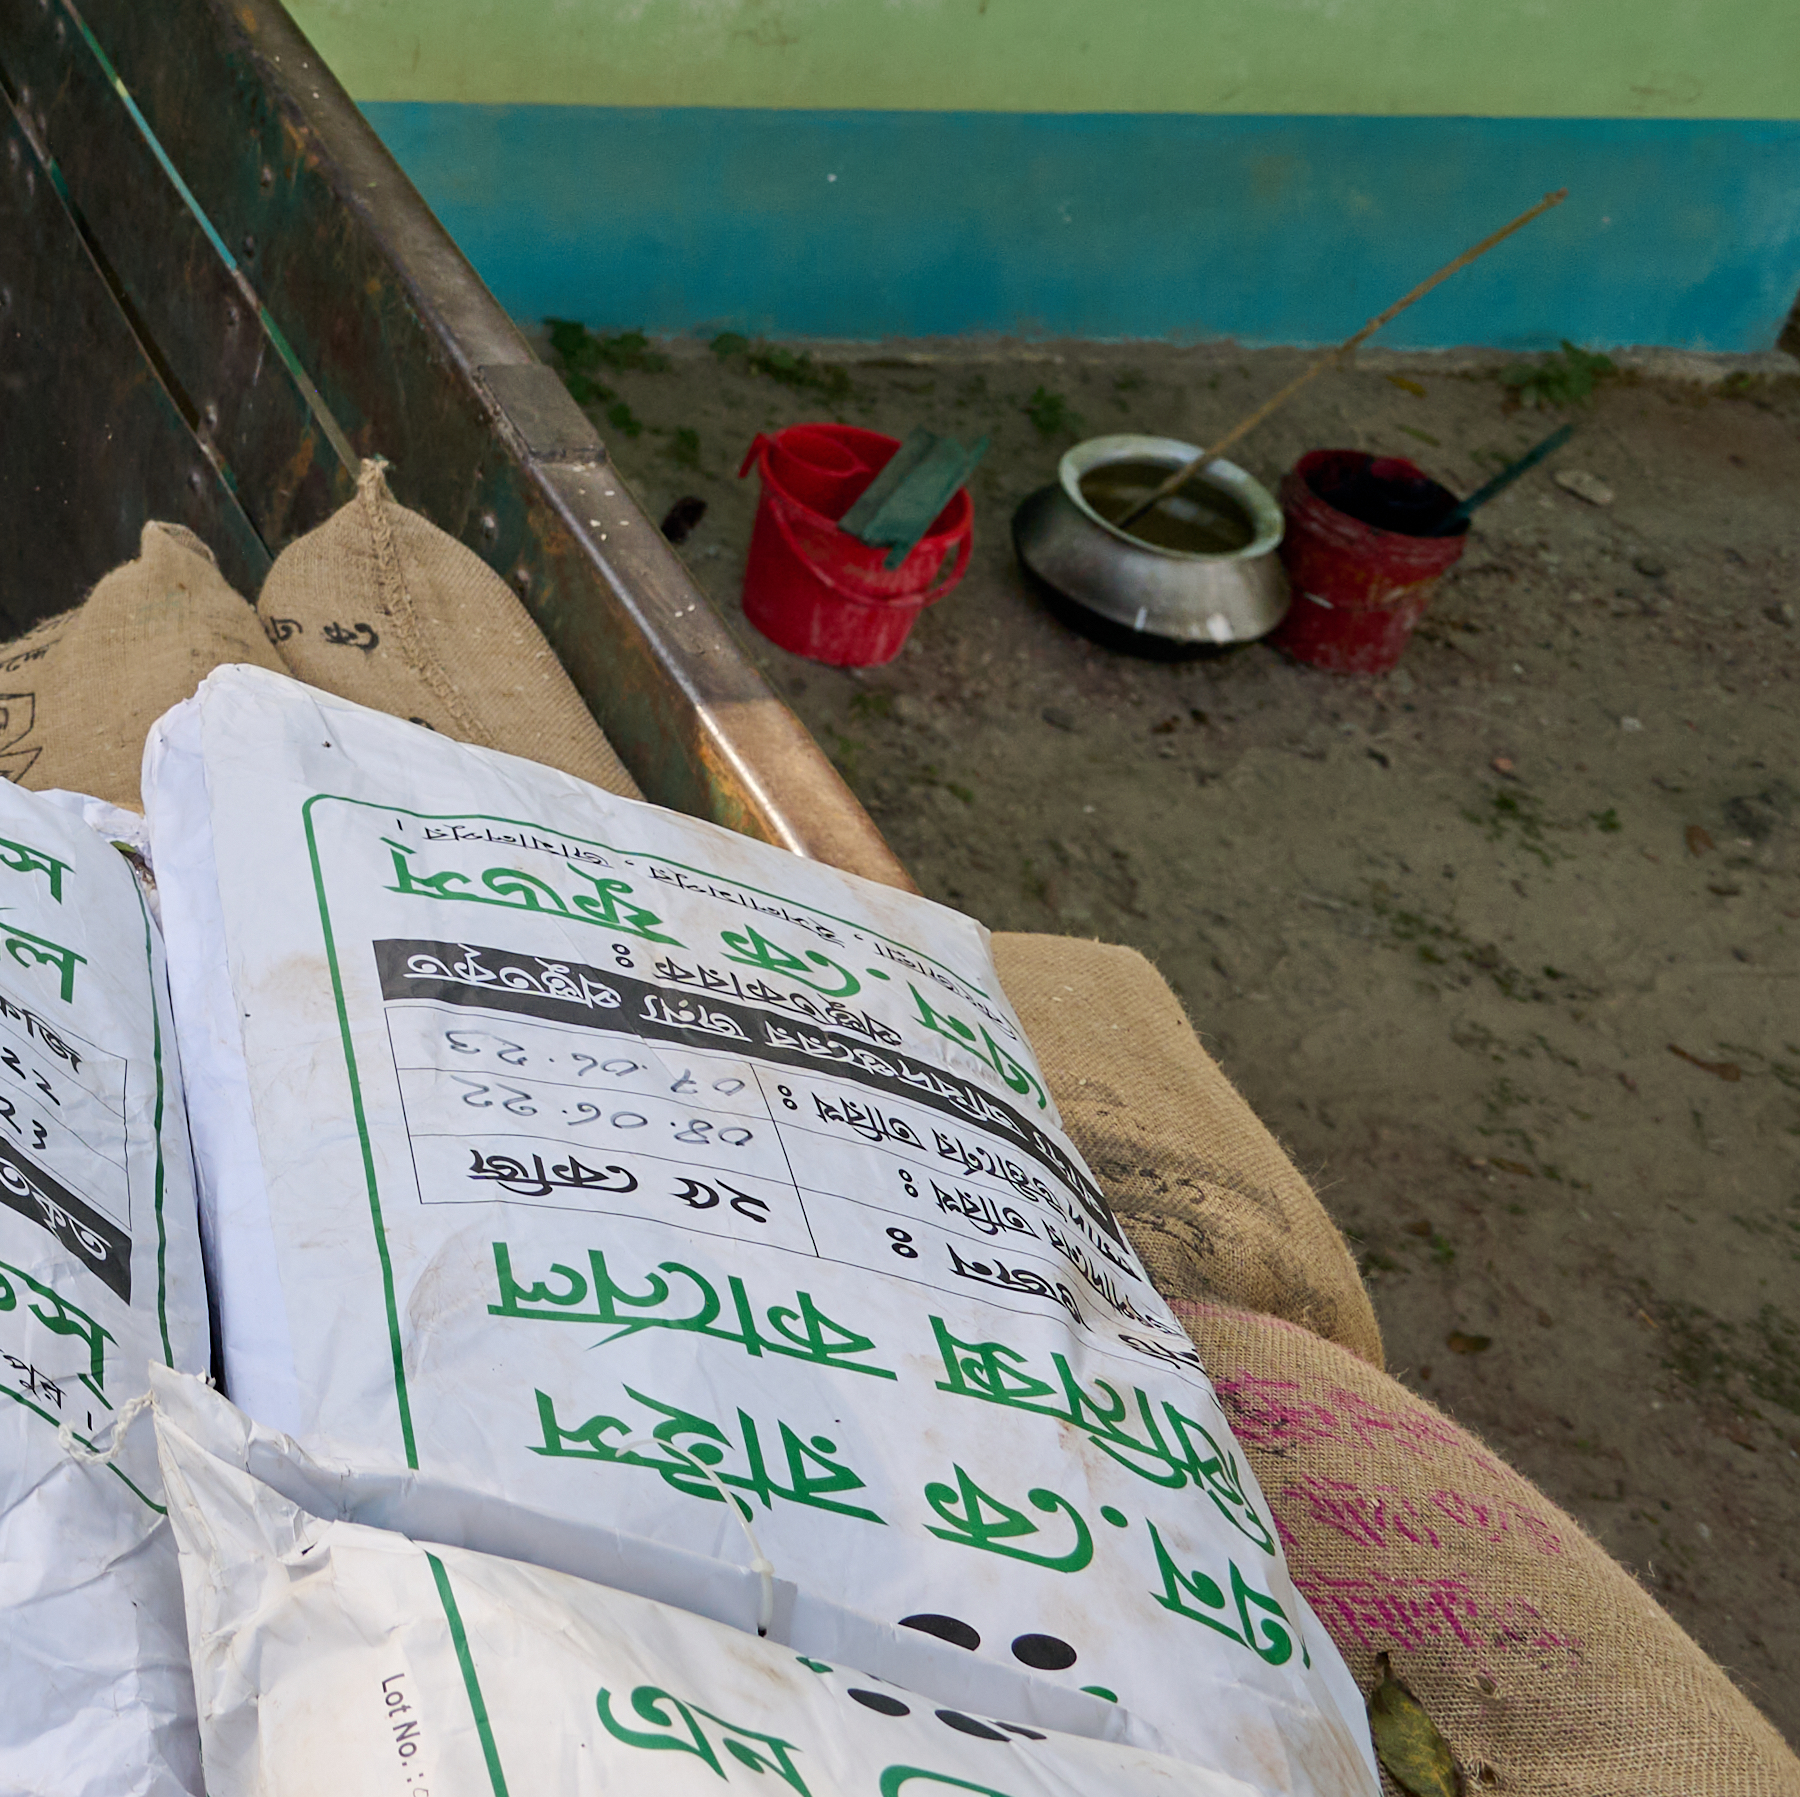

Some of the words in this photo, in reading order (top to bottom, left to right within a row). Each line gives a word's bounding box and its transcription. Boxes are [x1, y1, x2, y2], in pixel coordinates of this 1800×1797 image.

[640, 992, 753, 1044] জন্য
[813, 1093, 928, 1154] তারিখ
[467, 1149, 638, 1197] কেজি
[675, 1177, 770, 1224] ২৫
[929, 1178, 1040, 1242] তারিখ
[486, 1239, 898, 1381] কার্নেল
[524, 1382, 888, 1528] রাইস
[381, 1672, 413, 1718] Lot
